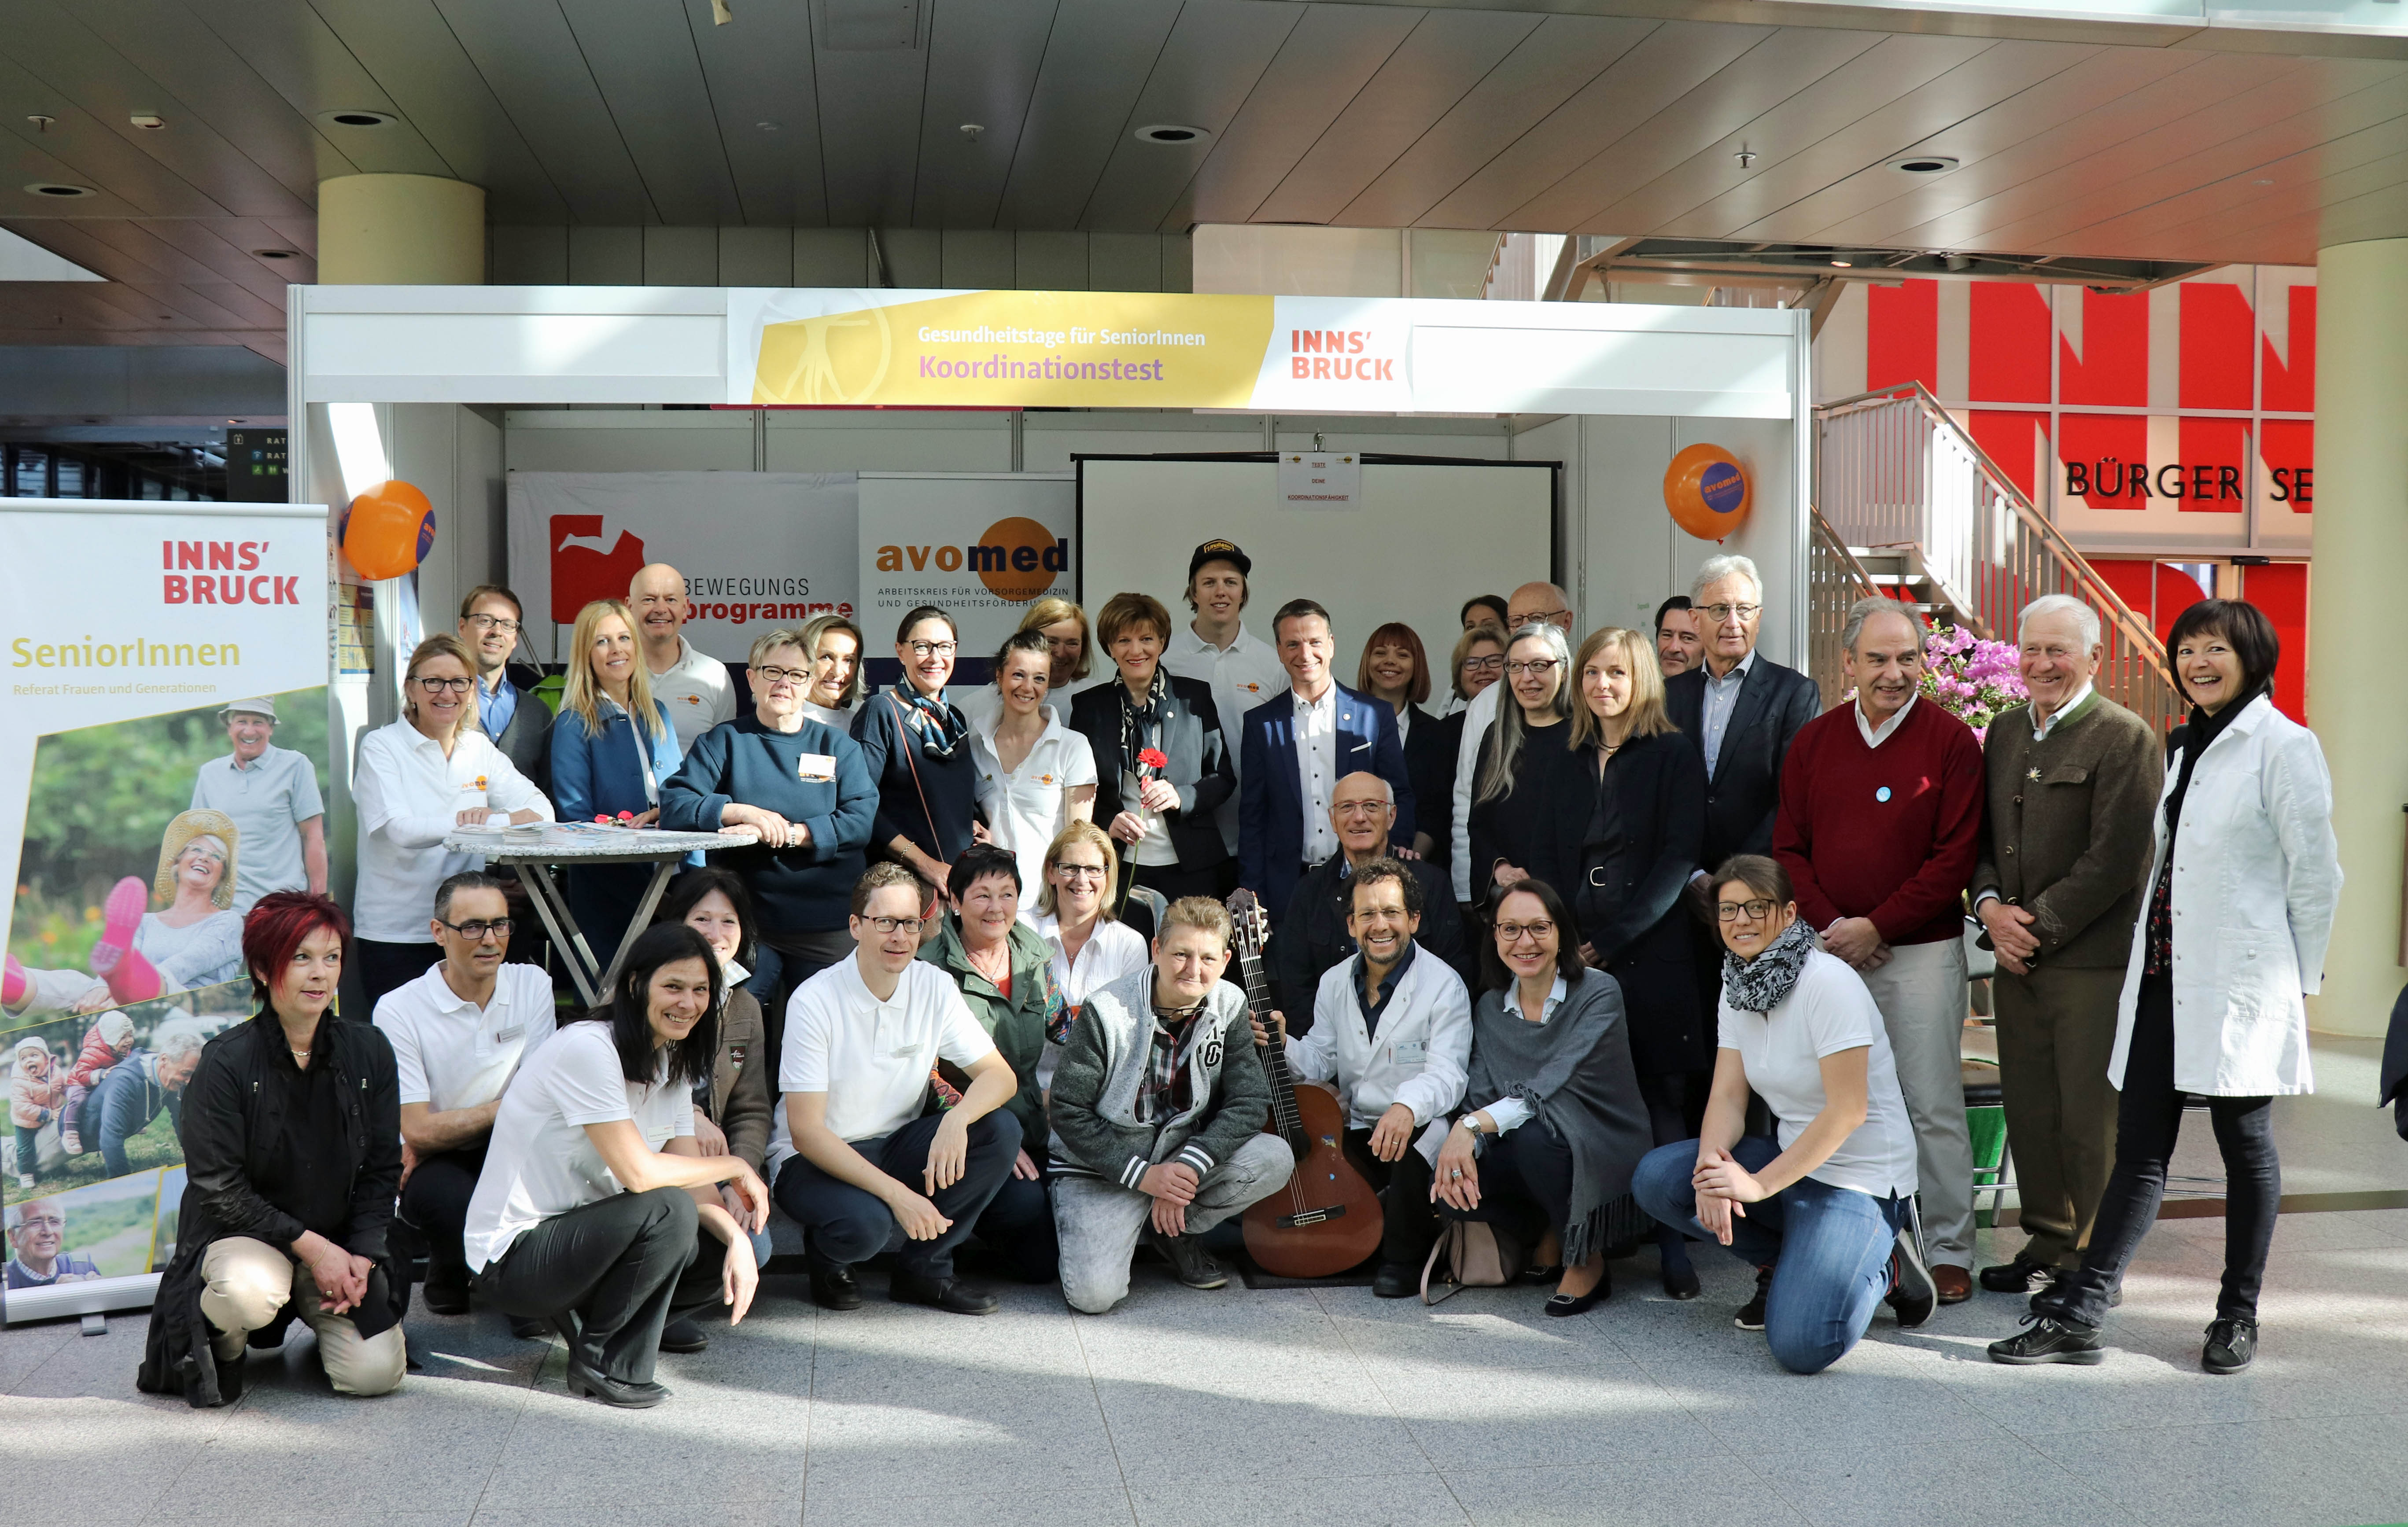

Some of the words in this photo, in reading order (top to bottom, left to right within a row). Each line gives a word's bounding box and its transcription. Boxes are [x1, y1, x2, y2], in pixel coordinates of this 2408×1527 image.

[918, 326, 1066, 349] Gesundheitstage
[1069, 326, 1096, 346] für
[1099, 327, 1206, 346] SeniorInnen
[919, 354, 1164, 381] Koordinationstest
[1291, 357, 1394, 382] BRUCK
[1704, 472, 1741, 493] avomed
[2067, 457, 2243, 500] BÜRGER
[876, 538, 1068, 572] avomed
[163, 576, 300, 604] BRUCK
[952, 587, 970, 596] FÜR
[907, 599, 1040, 607] GESUNDHEITSFÖRDERU
[12, 635, 240, 668] SeniorInnen
[14, 684, 59, 695] Referat
[63, 684, 105, 694] Frauen
[110, 683, 133, 694] und
[136, 682, 216, 693] Generationen
